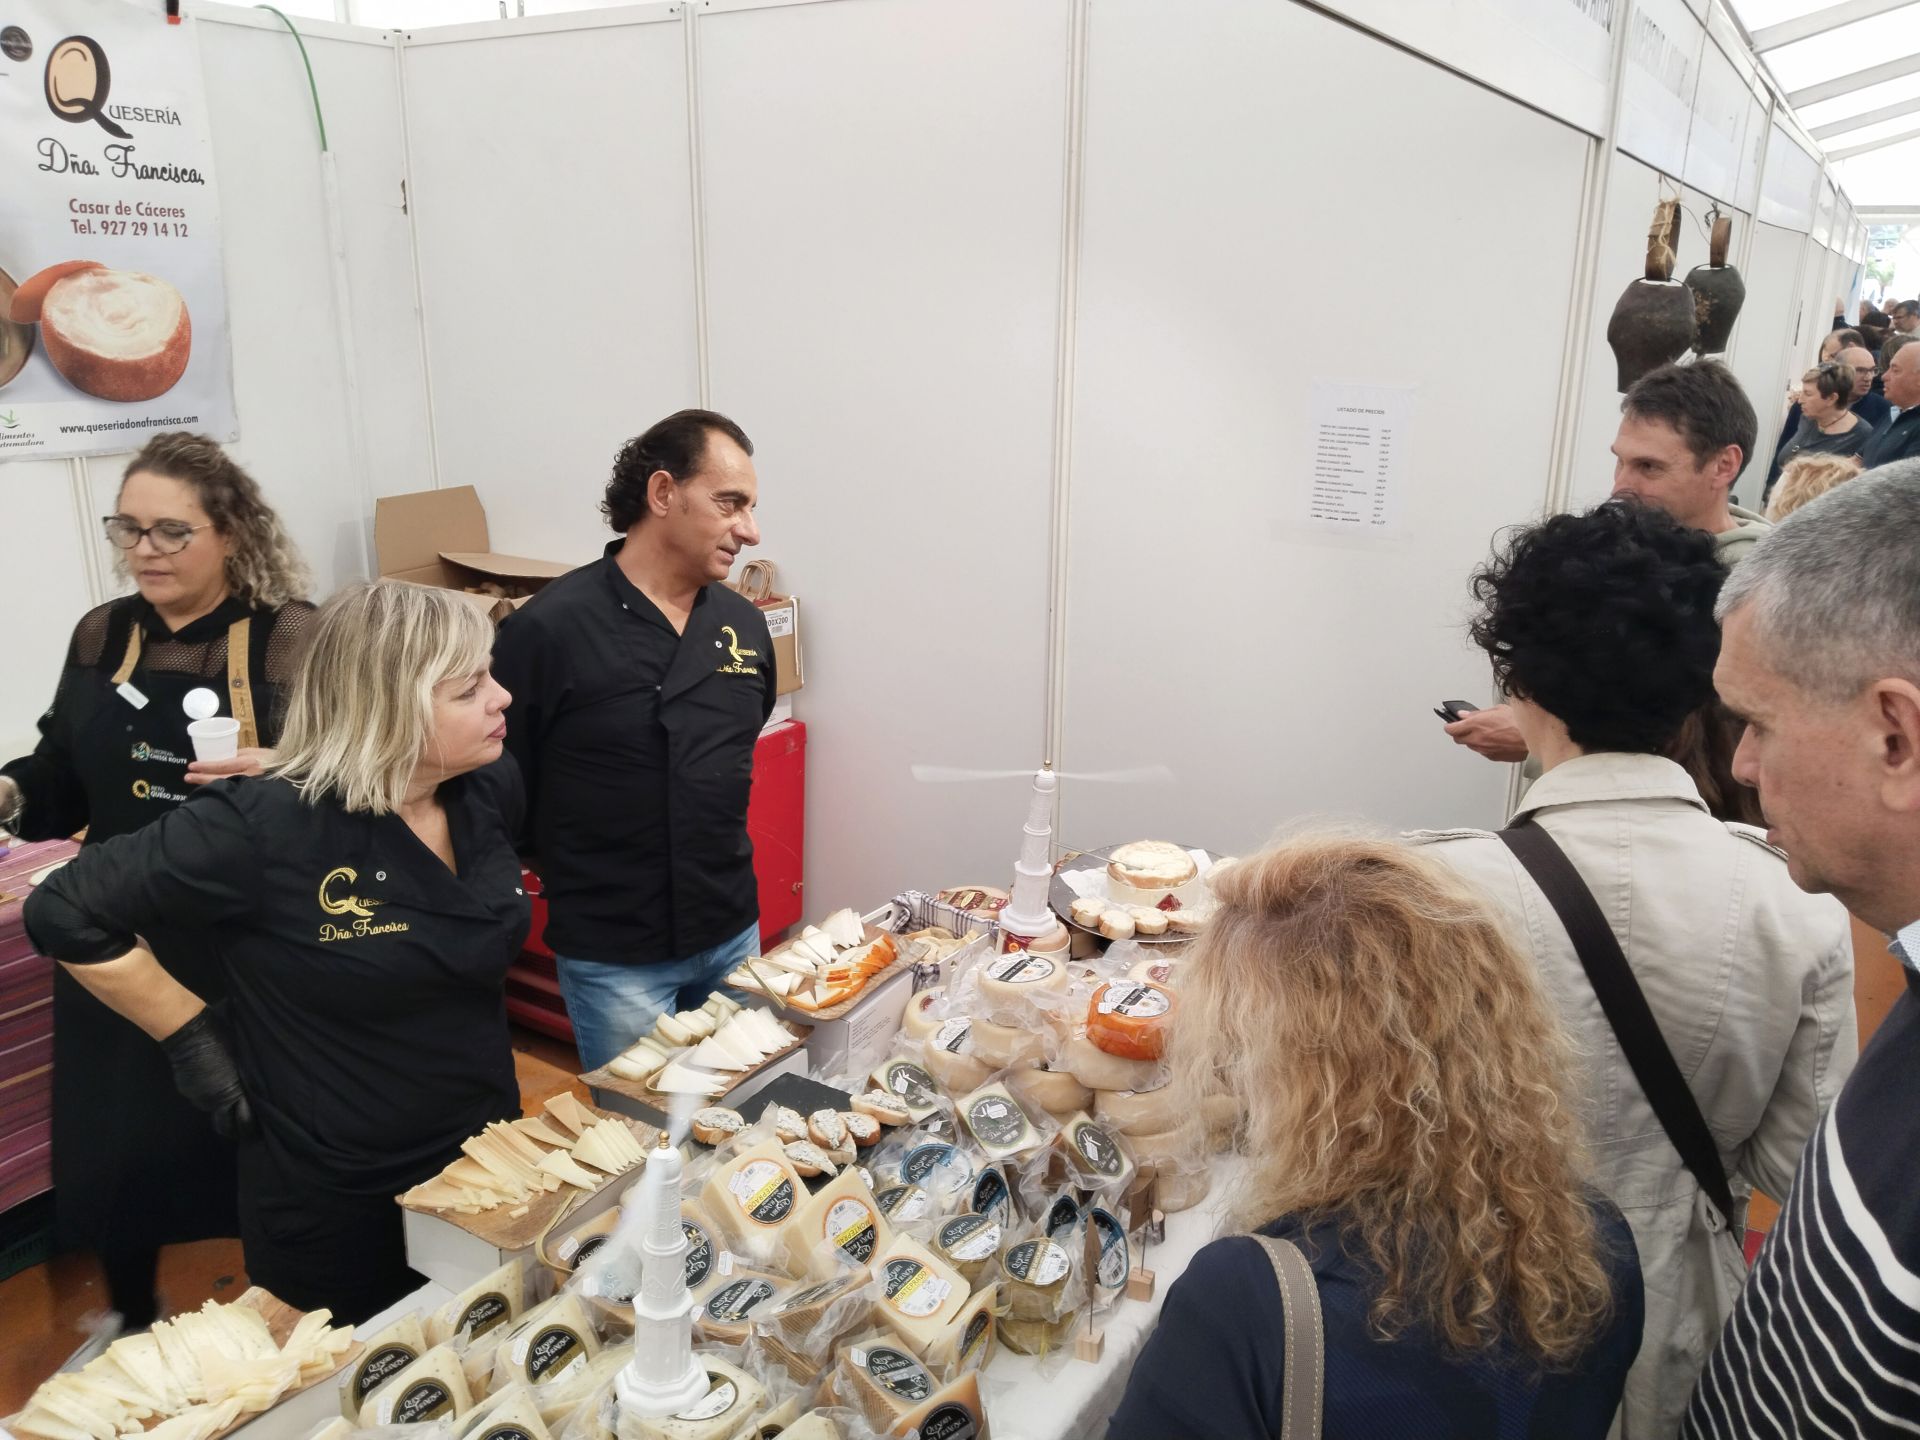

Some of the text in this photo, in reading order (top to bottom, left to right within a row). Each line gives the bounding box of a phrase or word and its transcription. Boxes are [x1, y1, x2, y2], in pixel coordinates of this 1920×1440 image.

[69, 198, 185, 218] Casar de Cáceres
[70, 218, 188, 238] Tel. 927 29 14 12
[59, 415, 199, 435] www.queseriadonafrancisca.com
[747, 1174, 785, 1211] MONTEPRADO
